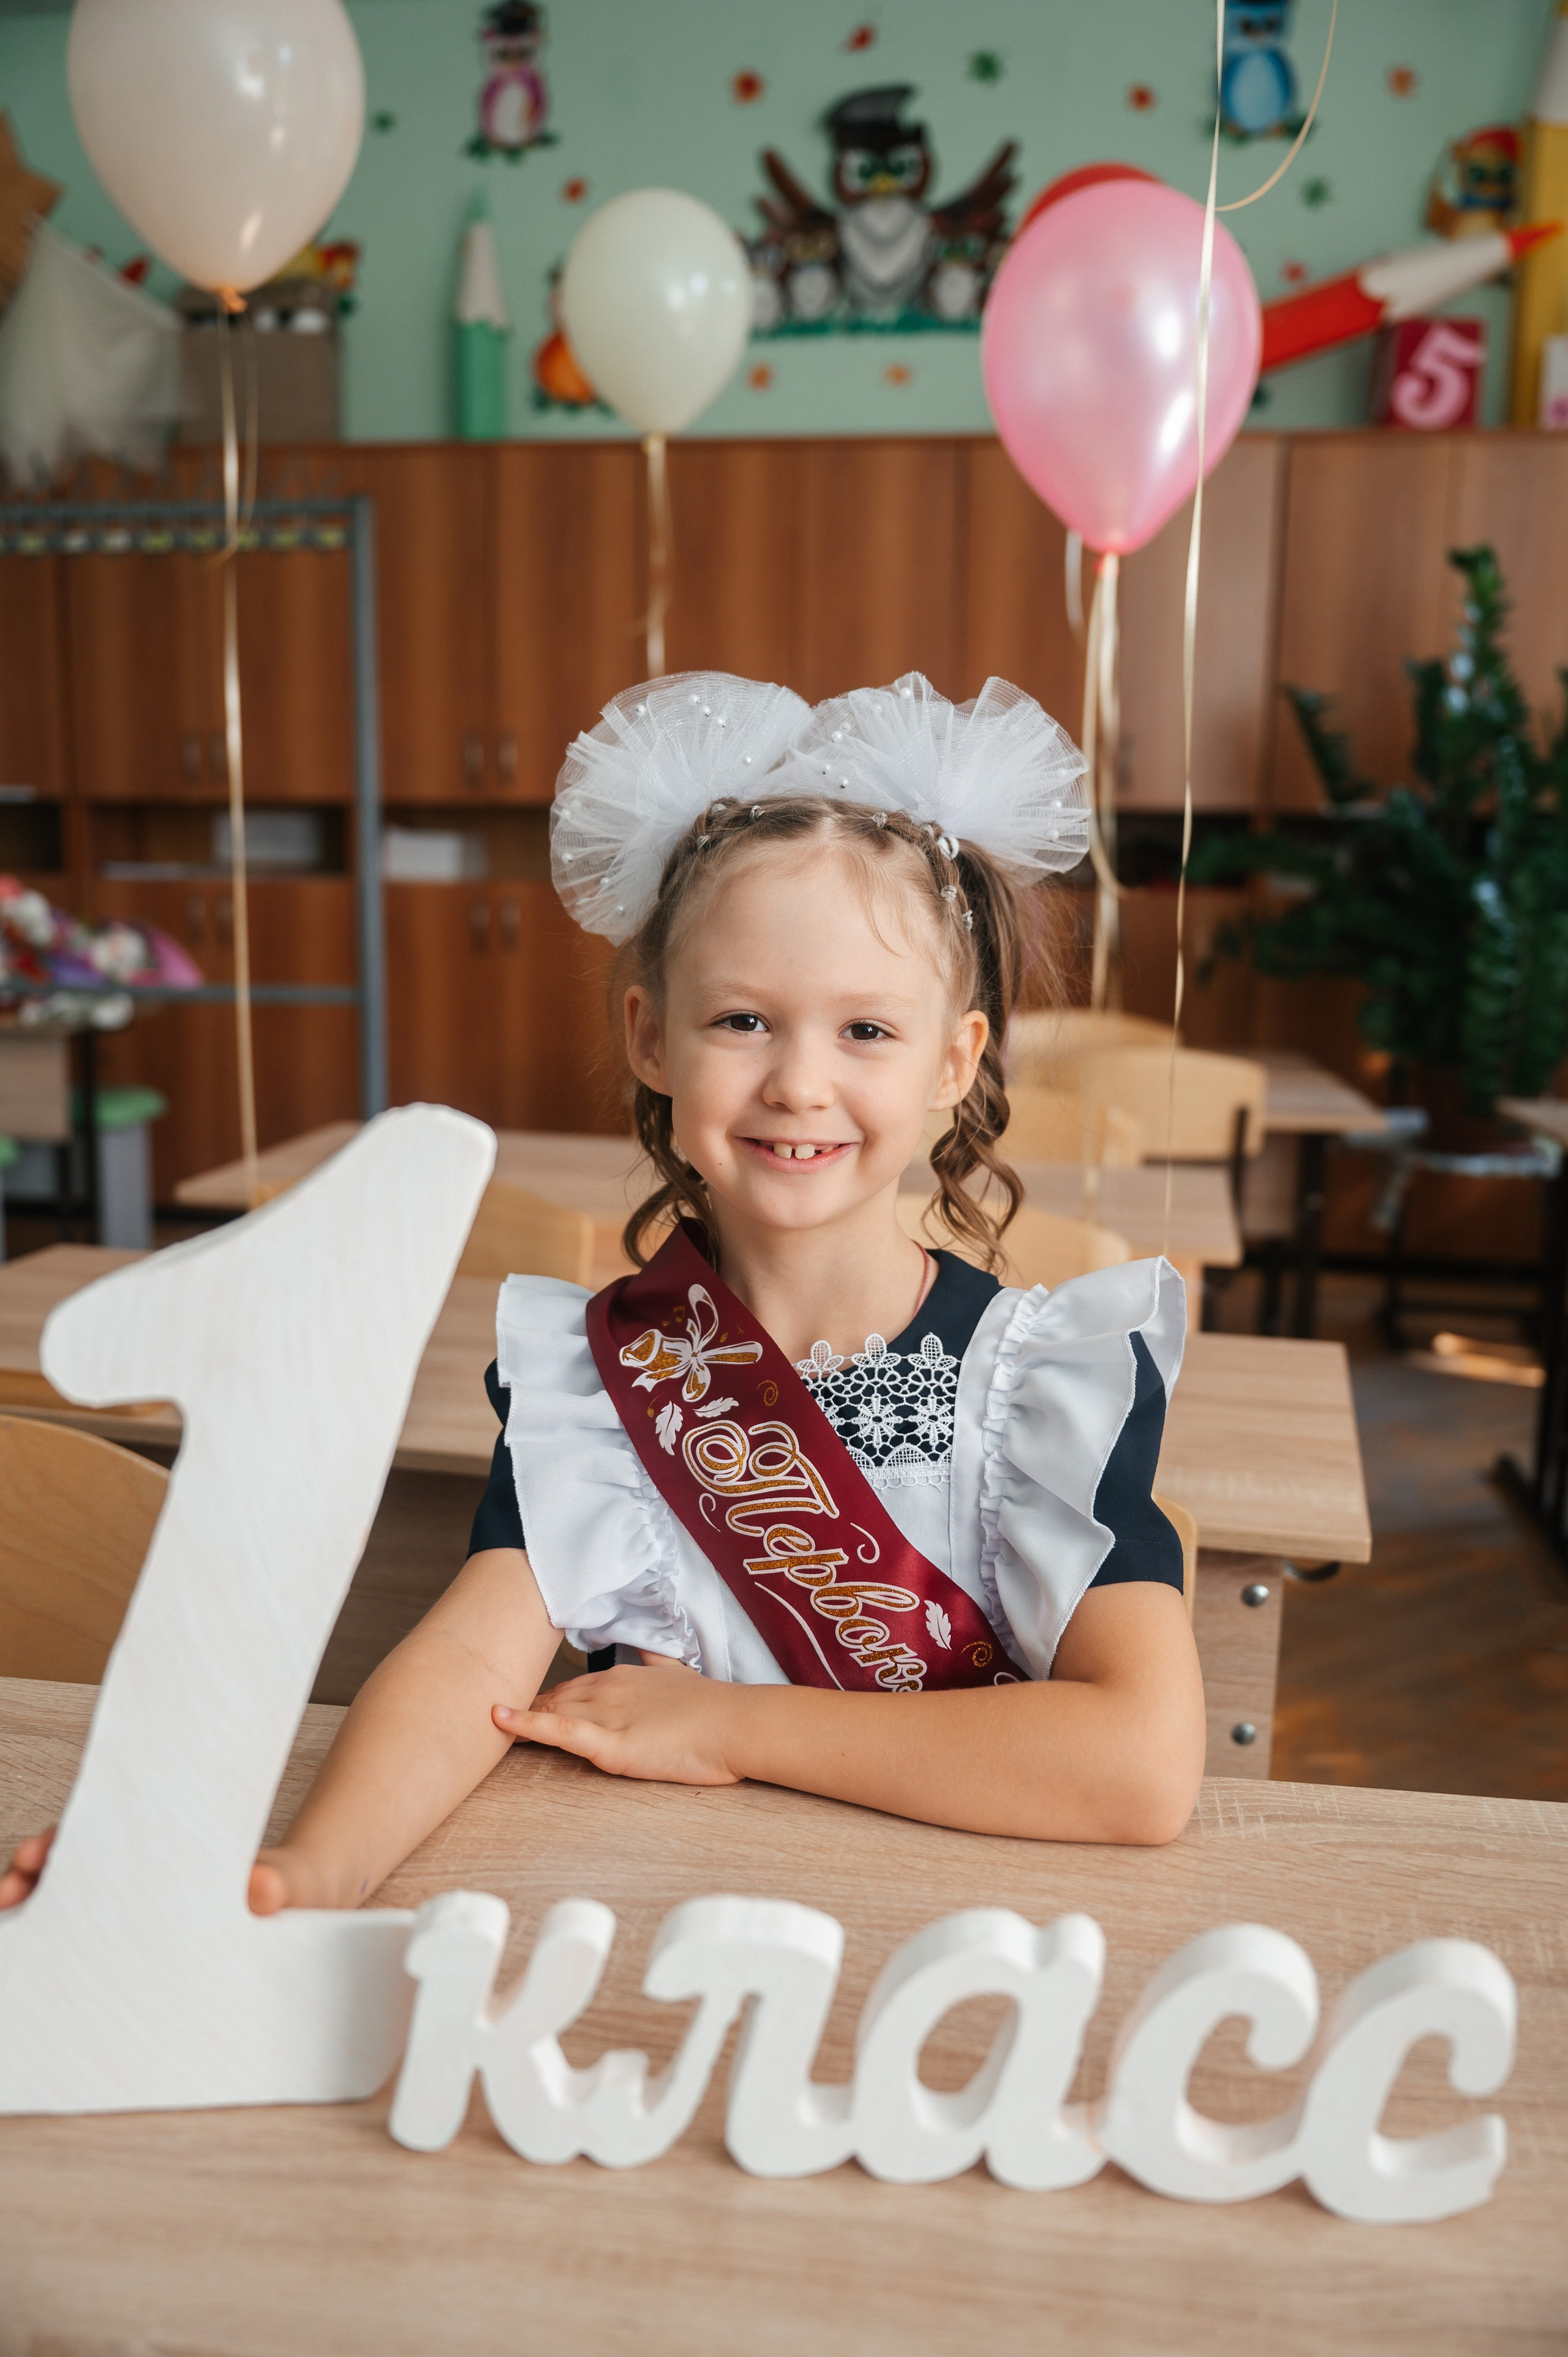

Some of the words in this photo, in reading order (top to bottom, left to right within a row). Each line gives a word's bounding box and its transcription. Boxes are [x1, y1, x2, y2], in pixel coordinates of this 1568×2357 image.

[1393, 323, 1485, 429] 5
[0, 1103, 496, 2114] 1
[388, 1889, 1516, 2223] класс
[682, 1420, 927, 1692] Первок
